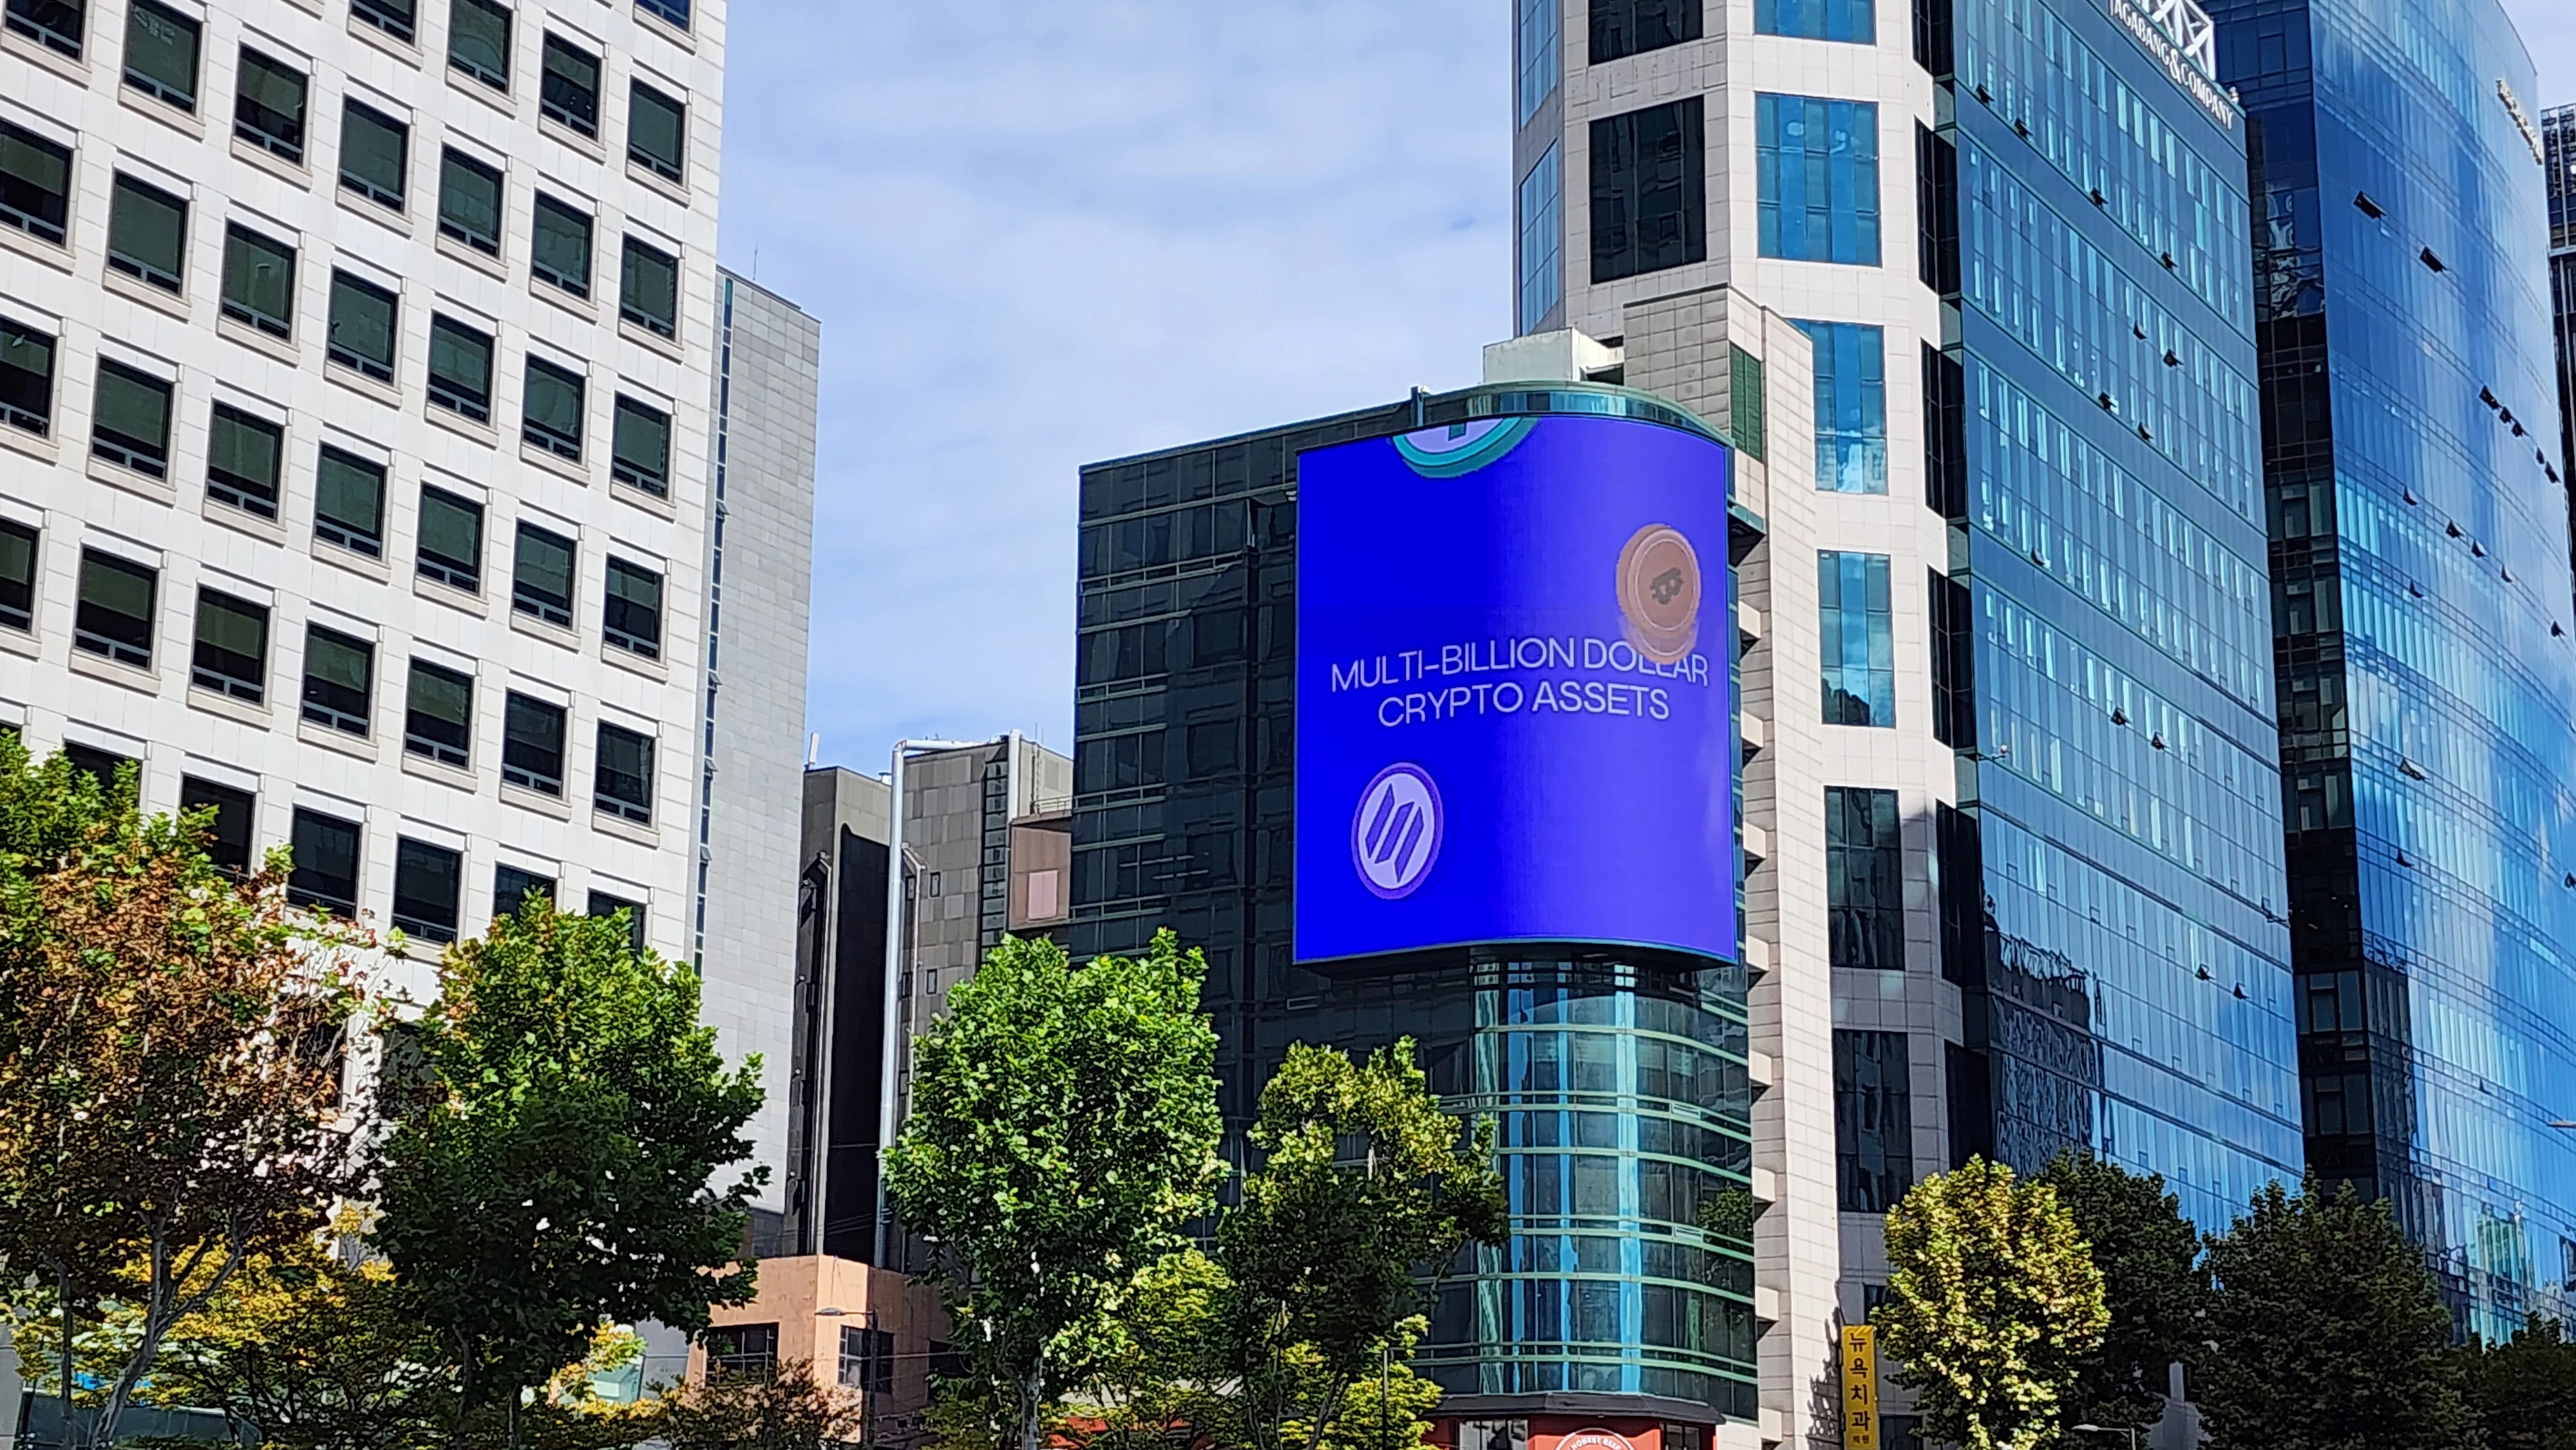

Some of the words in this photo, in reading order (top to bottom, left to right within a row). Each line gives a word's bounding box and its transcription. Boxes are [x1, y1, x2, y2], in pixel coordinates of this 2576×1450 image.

[1332, 637, 1575, 693] MULTI-BILLION
[1378, 682, 1523, 727] CRYPTO
[1531, 681, 1669, 720] ASSETS
[1848, 1332, 1871, 1432] 뉴욕치과
